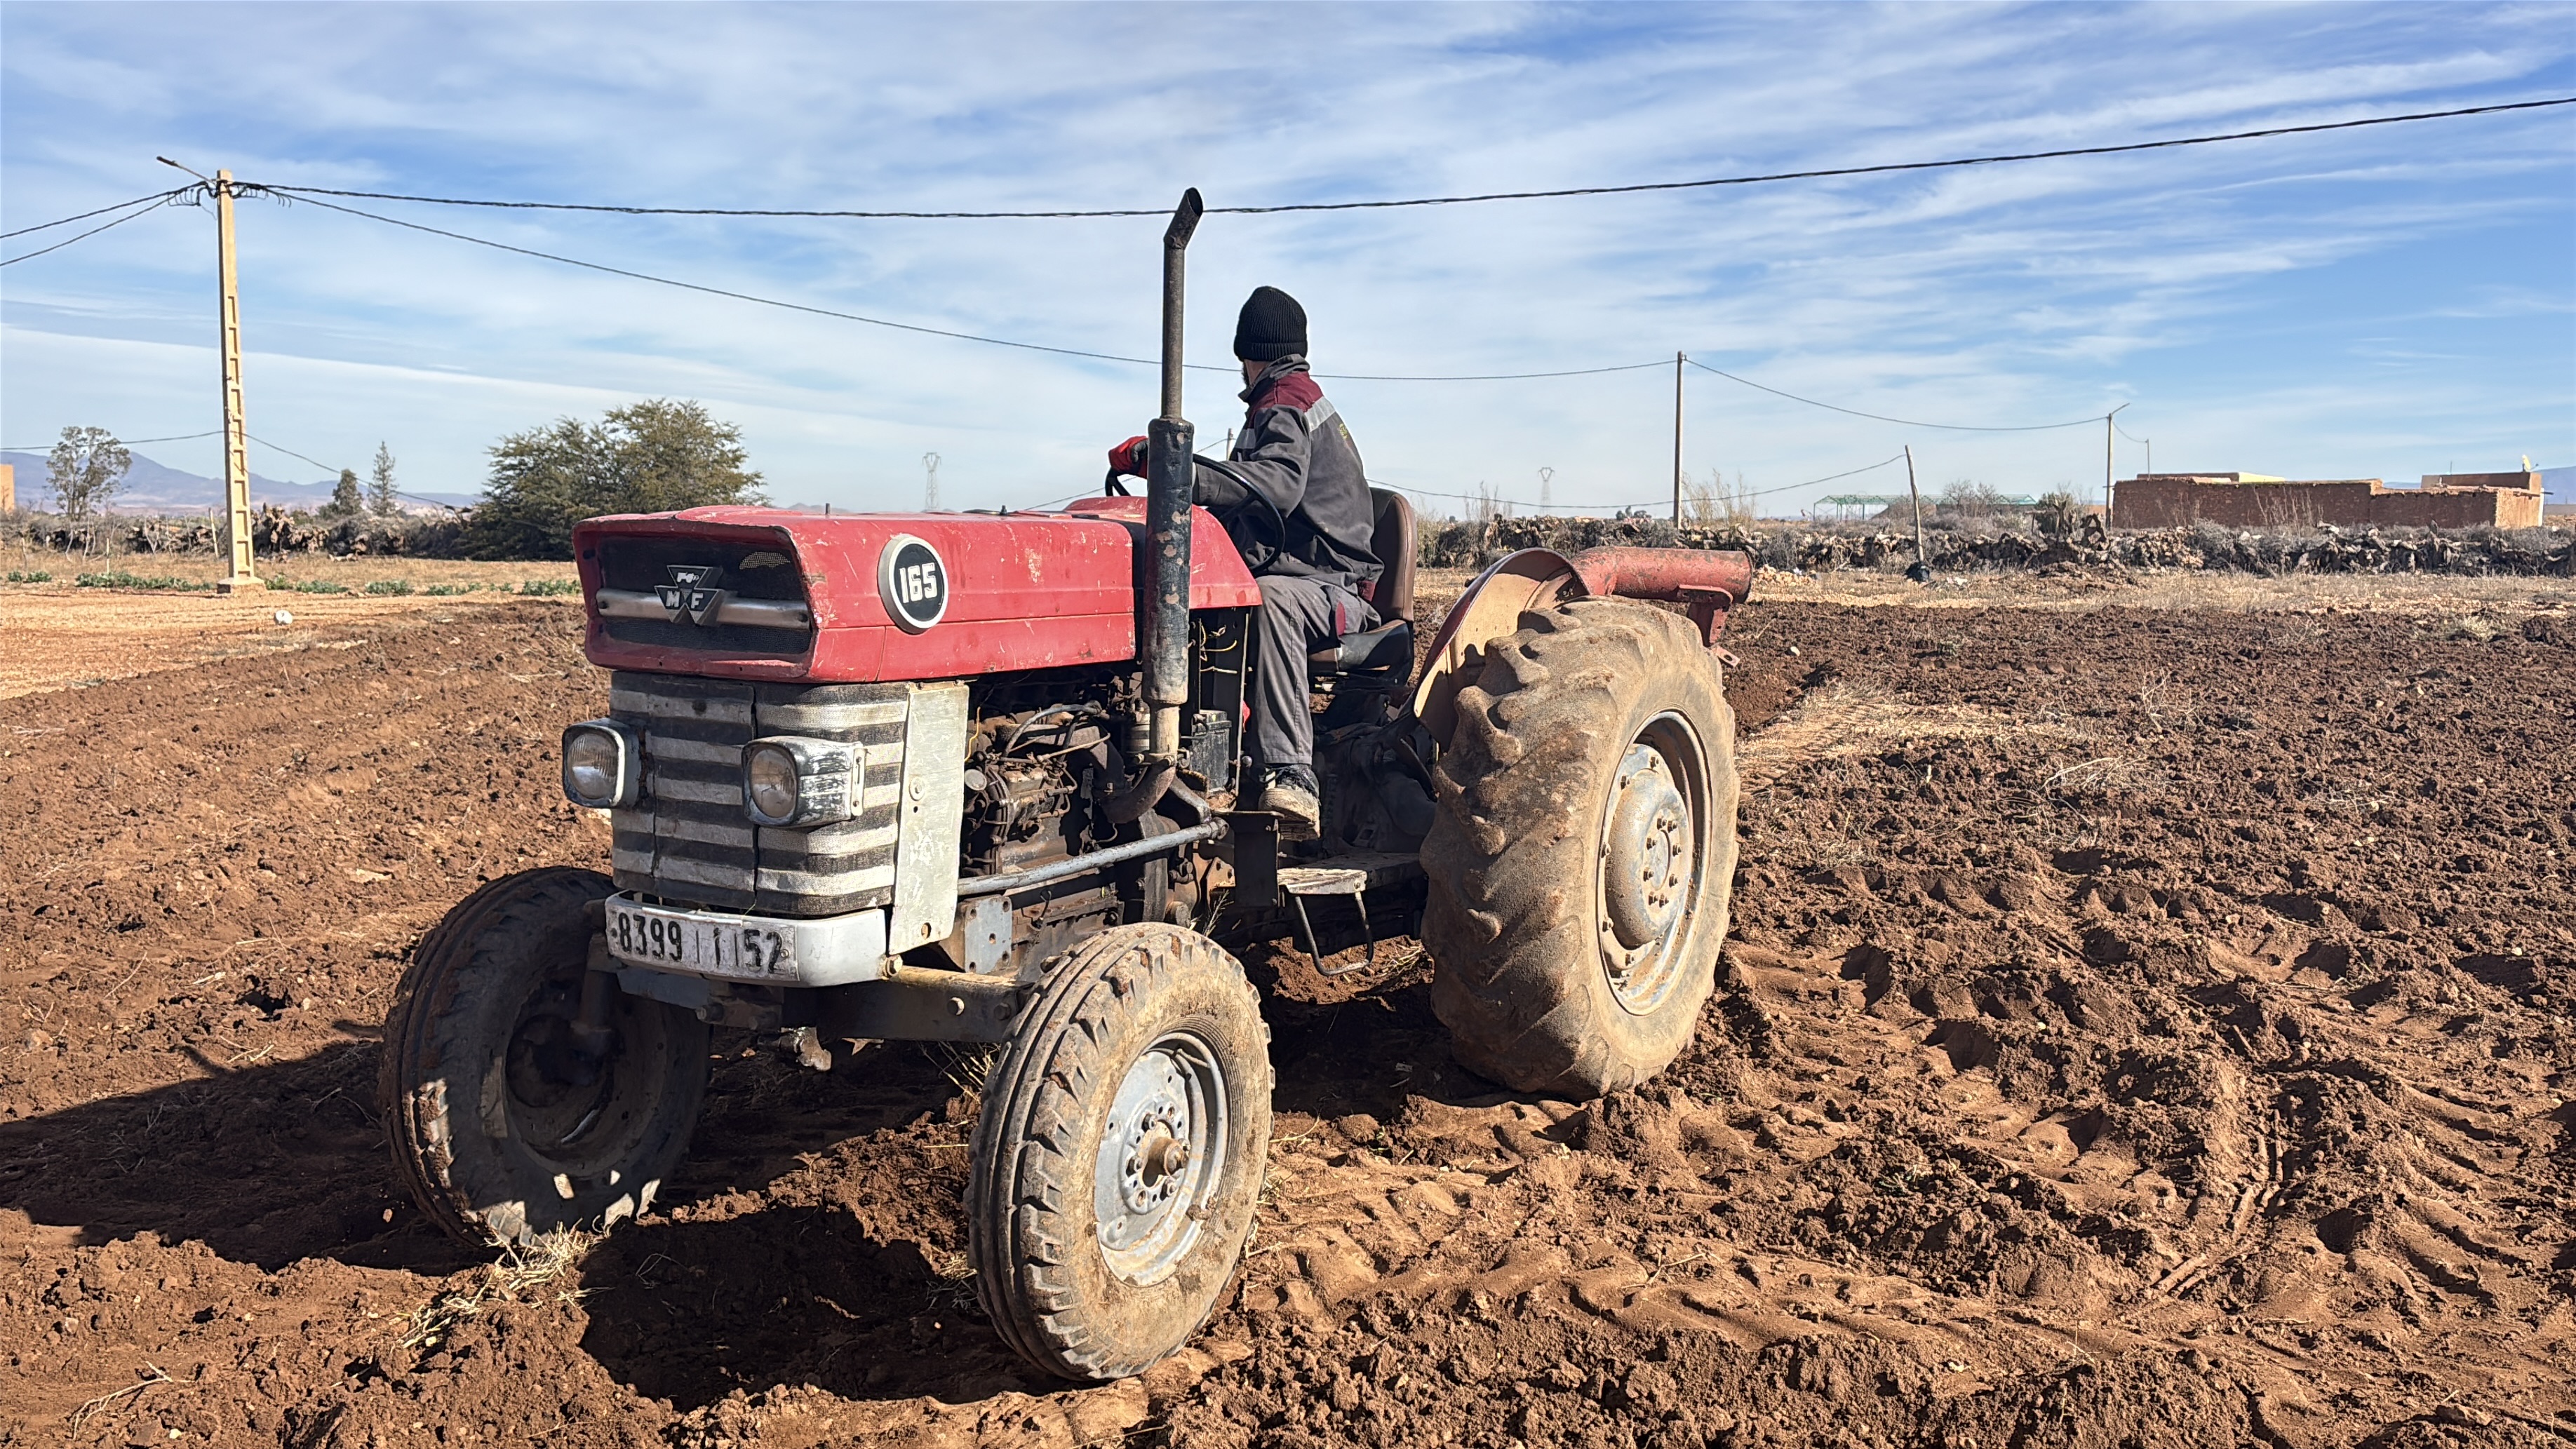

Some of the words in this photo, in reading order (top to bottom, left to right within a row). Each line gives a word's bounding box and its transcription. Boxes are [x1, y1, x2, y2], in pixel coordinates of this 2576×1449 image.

[899, 562, 937, 603] 165
[618, 912, 682, 962] 8399
[744, 929, 784, 974] 52
